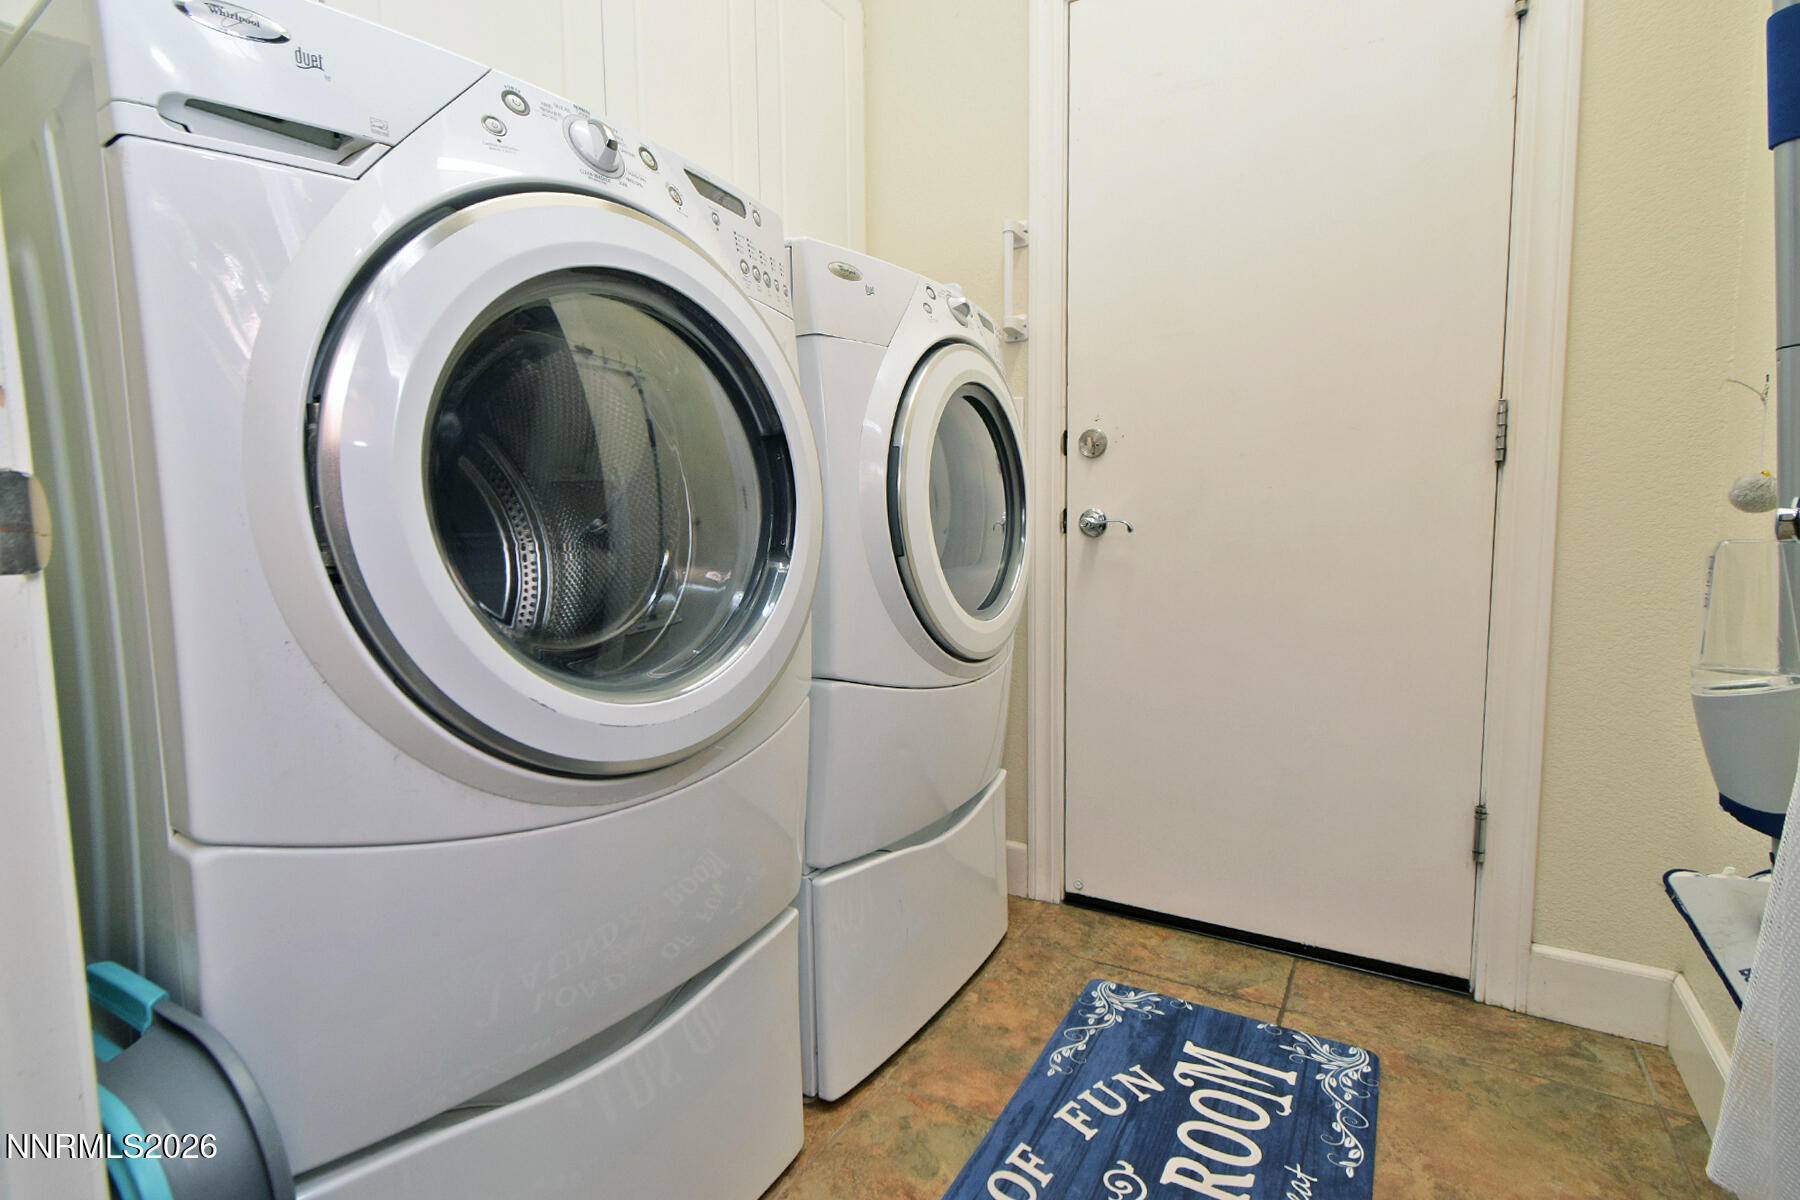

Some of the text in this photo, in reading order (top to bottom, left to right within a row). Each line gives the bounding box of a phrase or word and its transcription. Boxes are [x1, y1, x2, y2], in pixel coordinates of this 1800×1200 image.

[206, 4, 261, 28] Whirlpool
[294, 47, 325, 70] duet
[987, 1142, 1054, 1200] OF
[1053, 1064, 1165, 1141] FUN
[1160, 1040, 1298, 1200] ROOM
